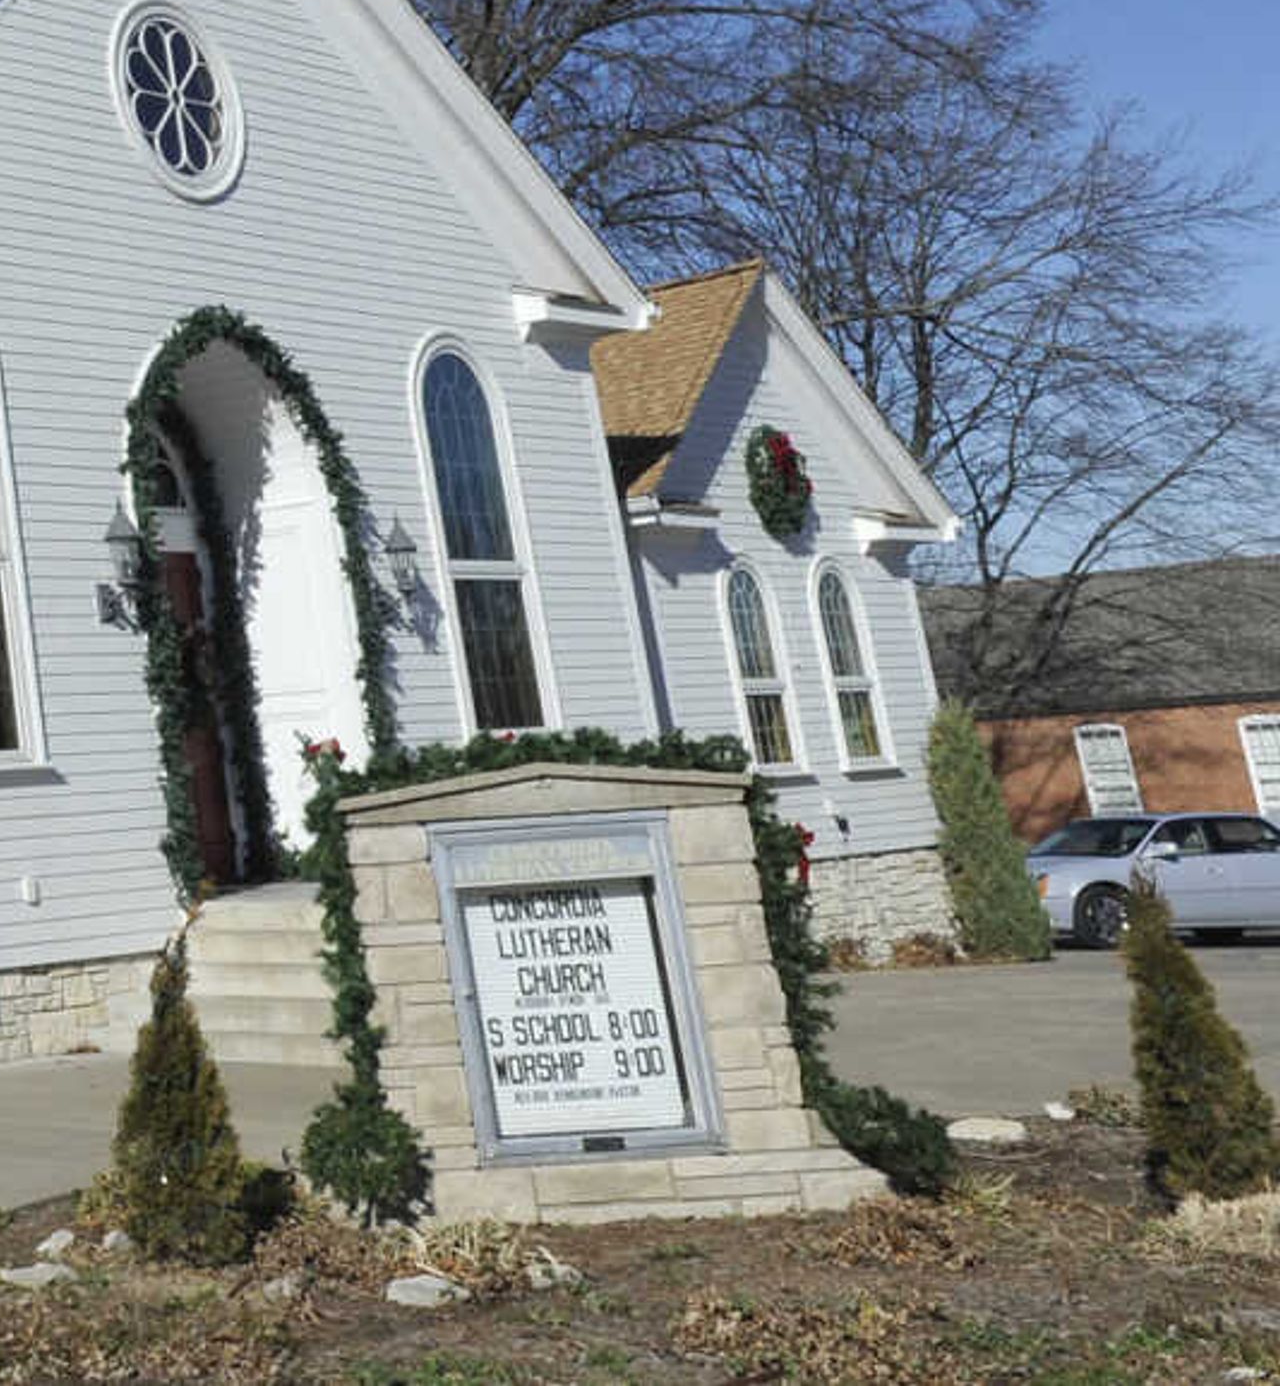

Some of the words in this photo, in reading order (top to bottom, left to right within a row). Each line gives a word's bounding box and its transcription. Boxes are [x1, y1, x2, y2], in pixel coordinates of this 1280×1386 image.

[490, 888, 607, 922] CONCORDIA
[496, 925, 612, 959] LUTHERAN
[517, 964, 608, 995] CHURCH
[488, 1018, 504, 1047] S
[512, 1013, 603, 1045] SCHOOL
[608, 1009, 659, 1041] 8:00
[493, 1051, 585, 1085] WORSHIP
